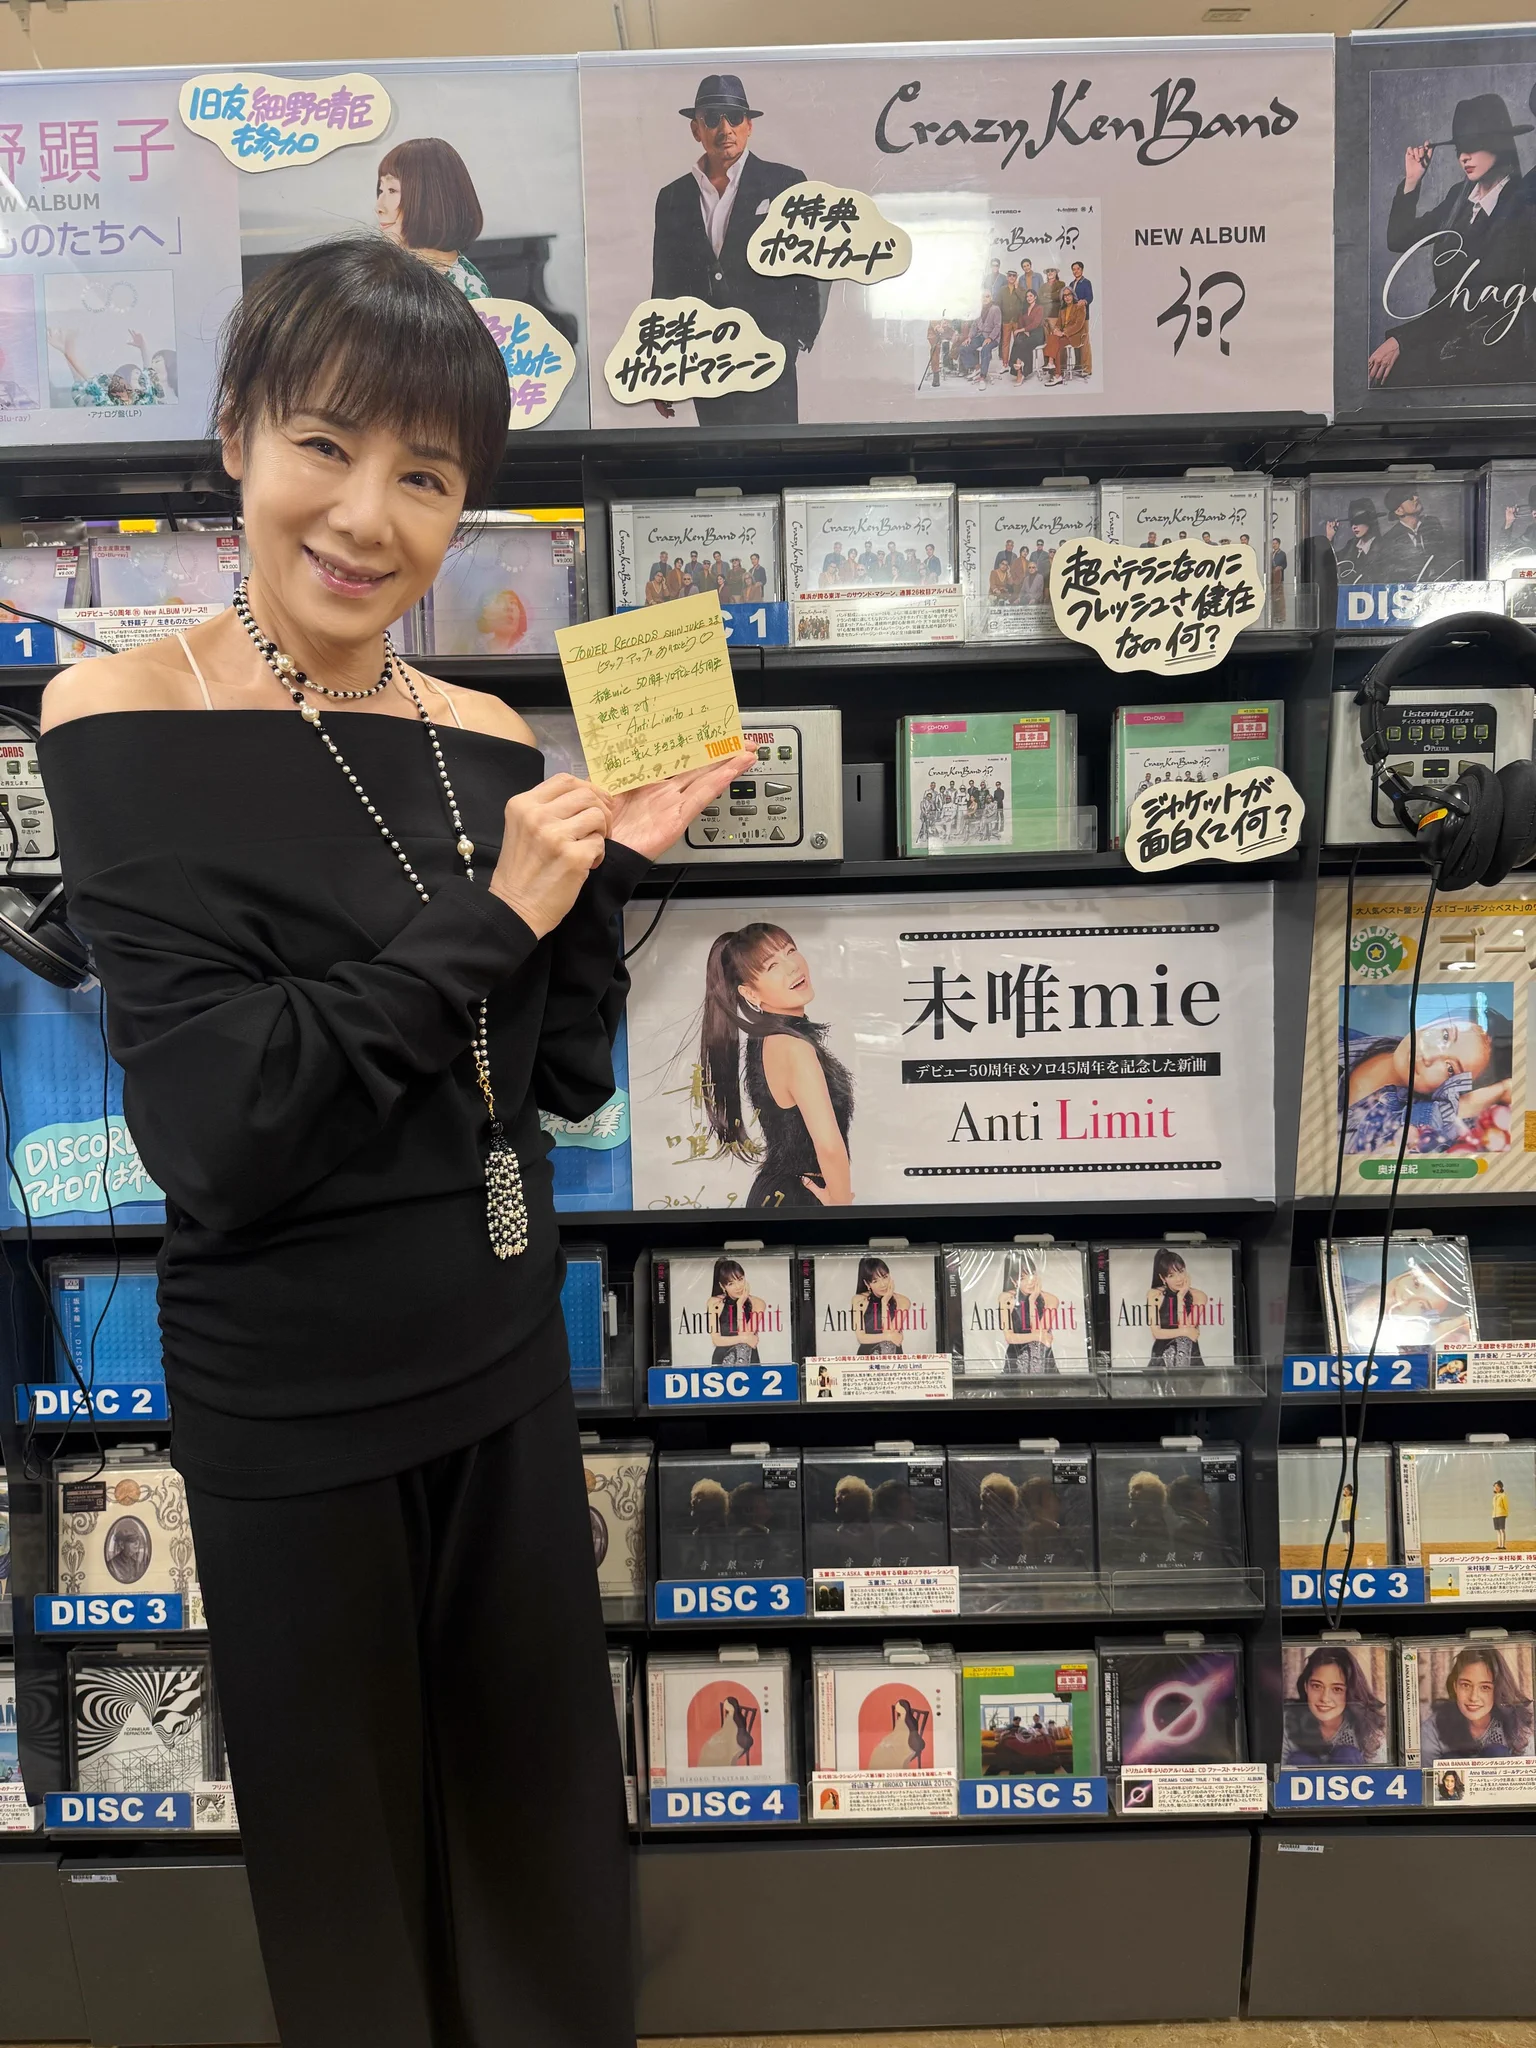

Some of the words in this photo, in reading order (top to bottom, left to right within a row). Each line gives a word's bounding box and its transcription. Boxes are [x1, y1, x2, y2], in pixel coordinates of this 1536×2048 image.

[190, 83, 375, 130] 旧友細野晴臣
[875, 80, 1029, 170] Crazy
[1024, 79, 1145, 159] Ken
[1136, 77, 1299, 166] Band
[231, 123, 319, 162] も参加
[26, 193, 100, 211] ALBUM
[781, 193, 860, 233] 特典
[1134, 228, 1184, 246] NEW
[1189, 226, 1267, 244] ALBUM
[759, 228, 897, 275] ポストカード
[1382, 230, 1536, 346] Chag
[635, 309, 741, 358] 東洋一の
[615, 351, 777, 392] サウンドマシーン
[1061, 545, 1242, 599] 超ベテランなのに
[1067, 580, 1256, 631] フレッシュさ健在
[750, 608, 767, 638] 1
[15, 628, 33, 657] 1
[1115, 621, 1221, 659] なの何?
[705, 736, 742, 759] TOWER
[1141, 775, 1275, 829] ジャケットが
[1136, 803, 1293, 863] 面白くて何?
[1350, 925, 1402, 952] GOLDEN
[1357, 963, 1394, 980] BEST
[902, 963, 1221, 1041] 未唯mie
[947, 1101, 1043, 1143] Anti
[1056, 1097, 1177, 1141] Limit
[678, 1305, 720, 1335] Anti
[728, 1304, 785, 1333] Limit
[823, 1302, 865, 1332] Anti
[872, 1302, 929, 1331] Limit
[970, 1300, 1014, 1331] Anti
[1020, 1299, 1078, 1331] Limit
[1117, 1298, 1161, 1327] Anti
[1168, 1297, 1225, 1327] Limit
[665, 1371, 759, 1399] DISC
[762, 1370, 783, 1396] 2
[1293, 1360, 1378, 1386] DISC
[1390, 1359, 1412, 1384] 2
[35, 1389, 120, 1415] DISC
[131, 1388, 153, 1414] 2
[673, 1585, 758, 1613] DISC
[770, 1584, 791, 1611] 3
[1291, 1573, 1376, 1599] DISC
[1388, 1572, 1409, 1598] 3
[52, 1598, 135, 1626] DISC
[147, 1597, 167, 1624] 3
[976, 1782, 1060, 1809] DISC
[1072, 1782, 1093, 1808] 5
[1290, 1775, 1375, 1801] DISC
[1385, 1774, 1408, 1800] 4
[61, 1796, 145, 1822] DISC
[155, 1796, 177, 1822] 4
[667, 1790, 752, 1818] DISC
[762, 1789, 784, 1815] 4
